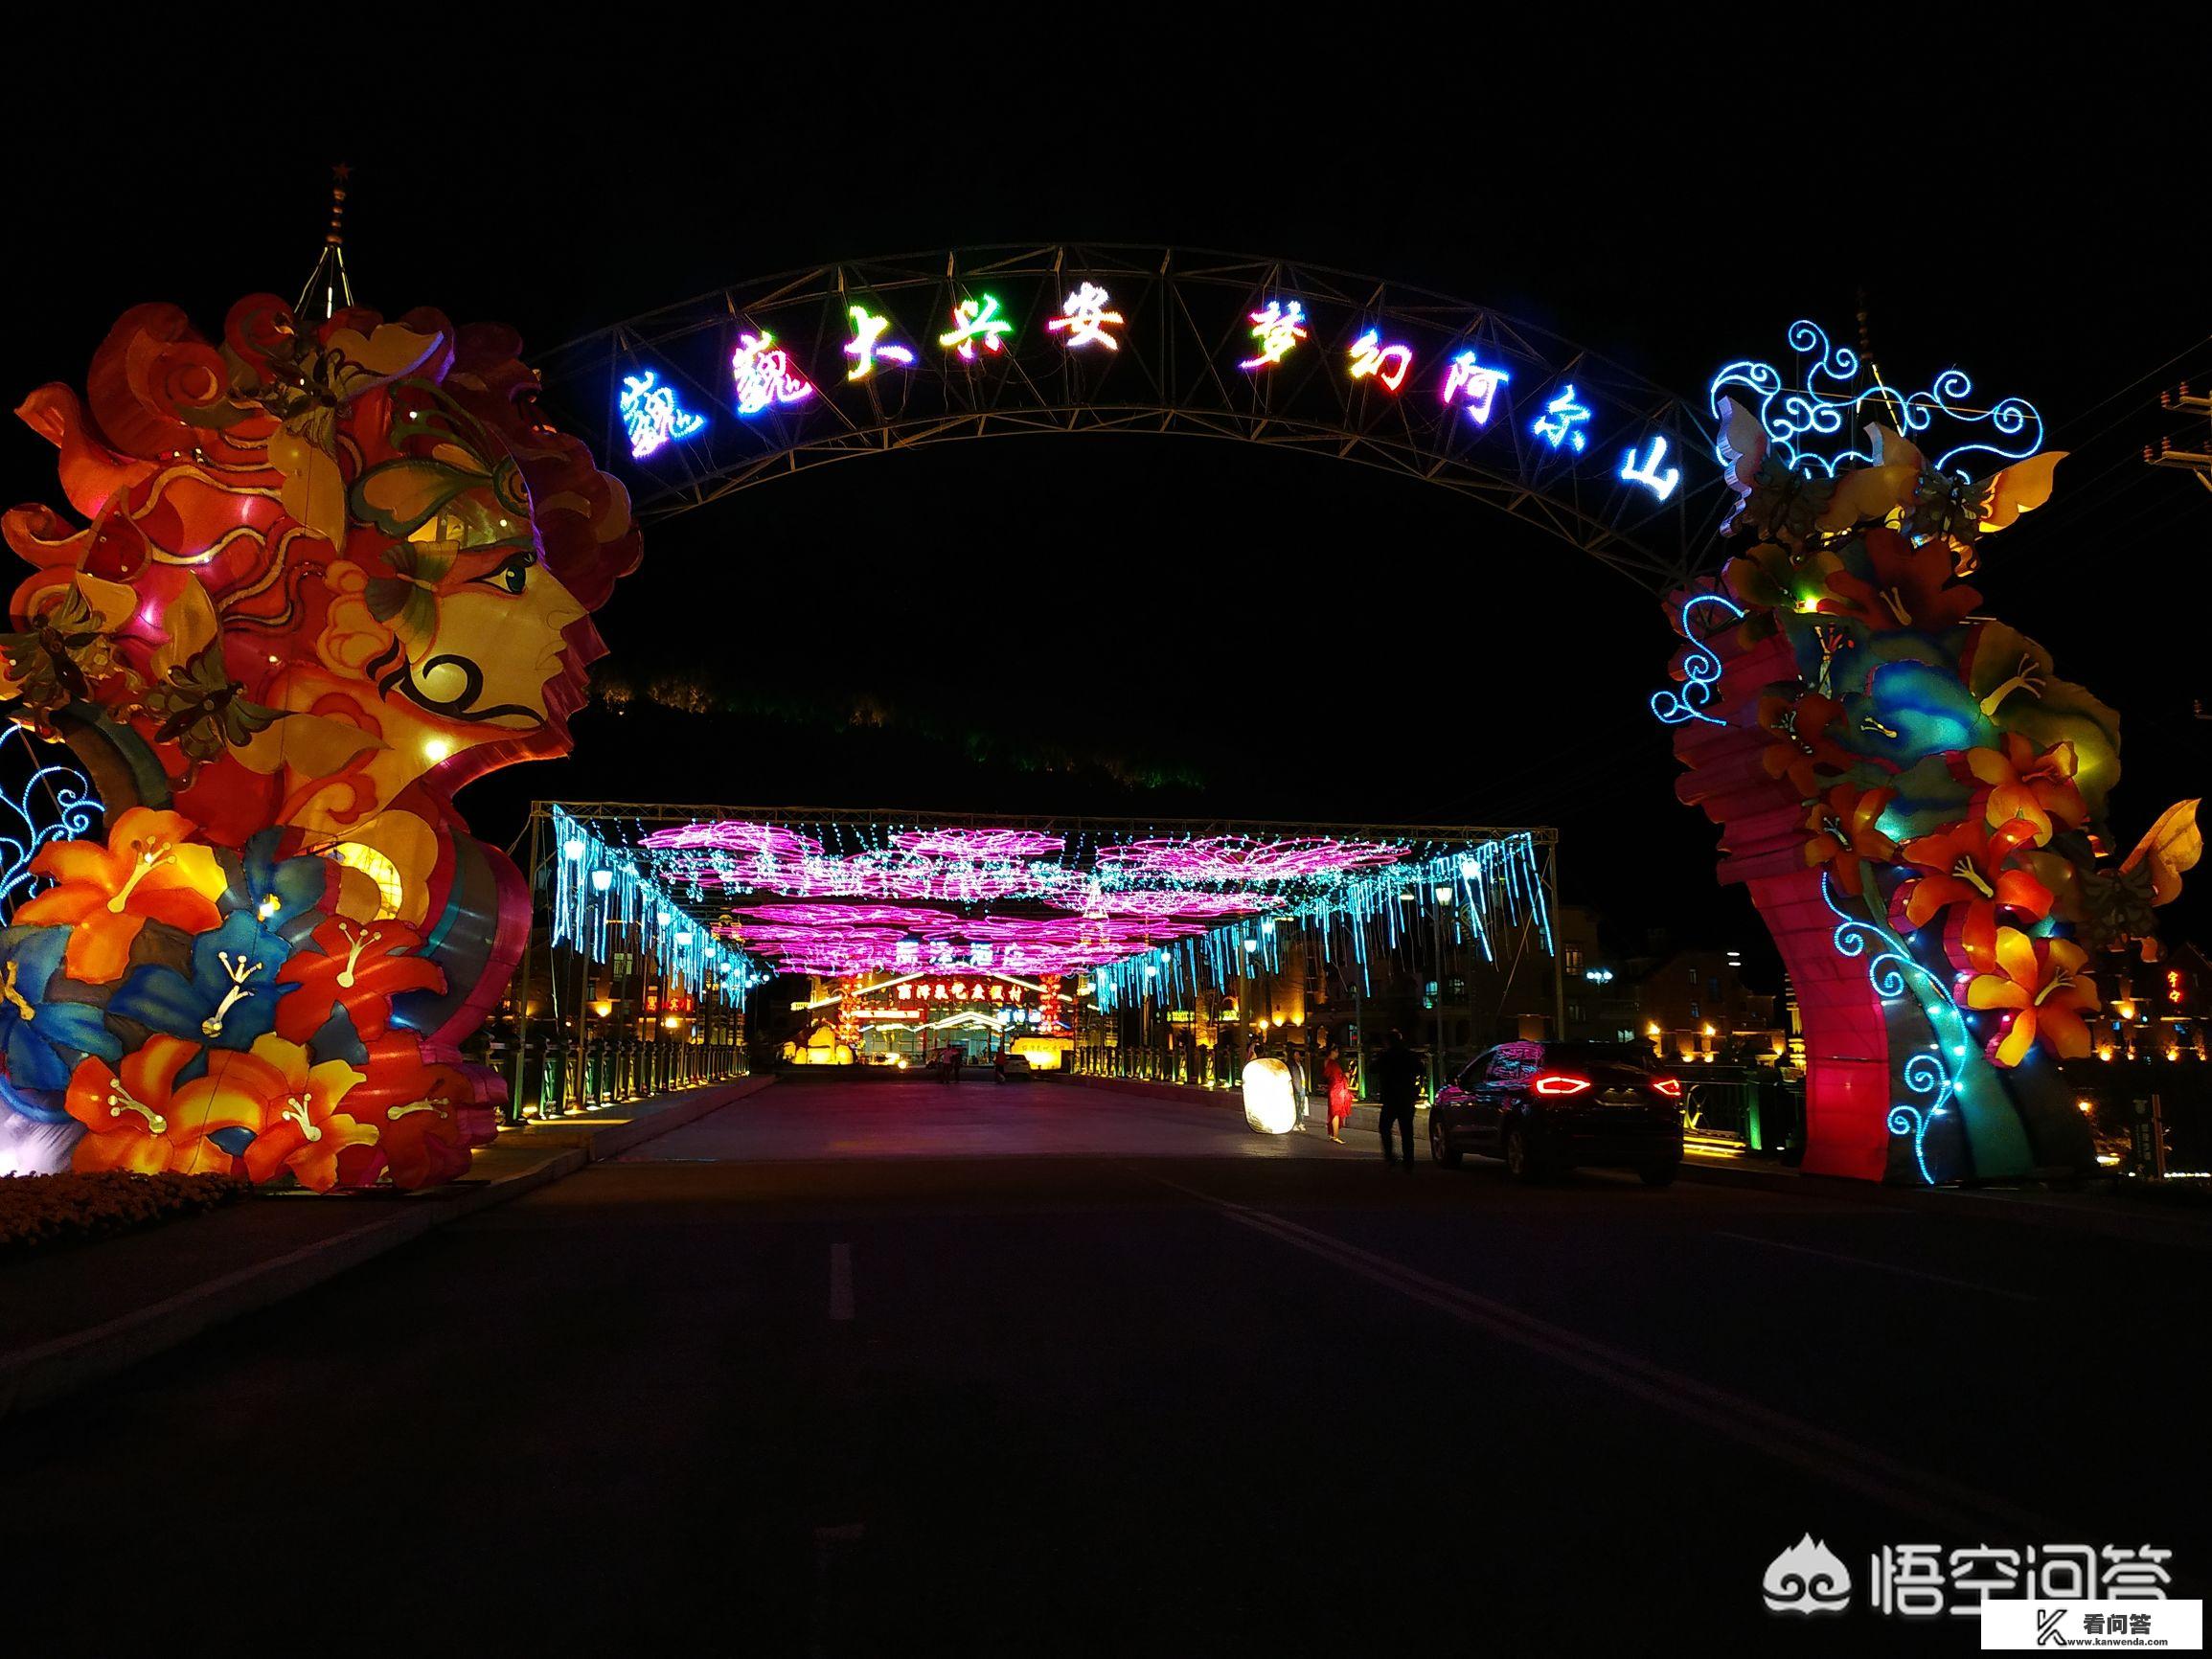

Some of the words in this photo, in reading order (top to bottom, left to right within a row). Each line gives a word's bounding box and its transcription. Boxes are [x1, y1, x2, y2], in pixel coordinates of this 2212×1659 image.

[1238, 300, 1680, 502] 梦幻阿尔山
